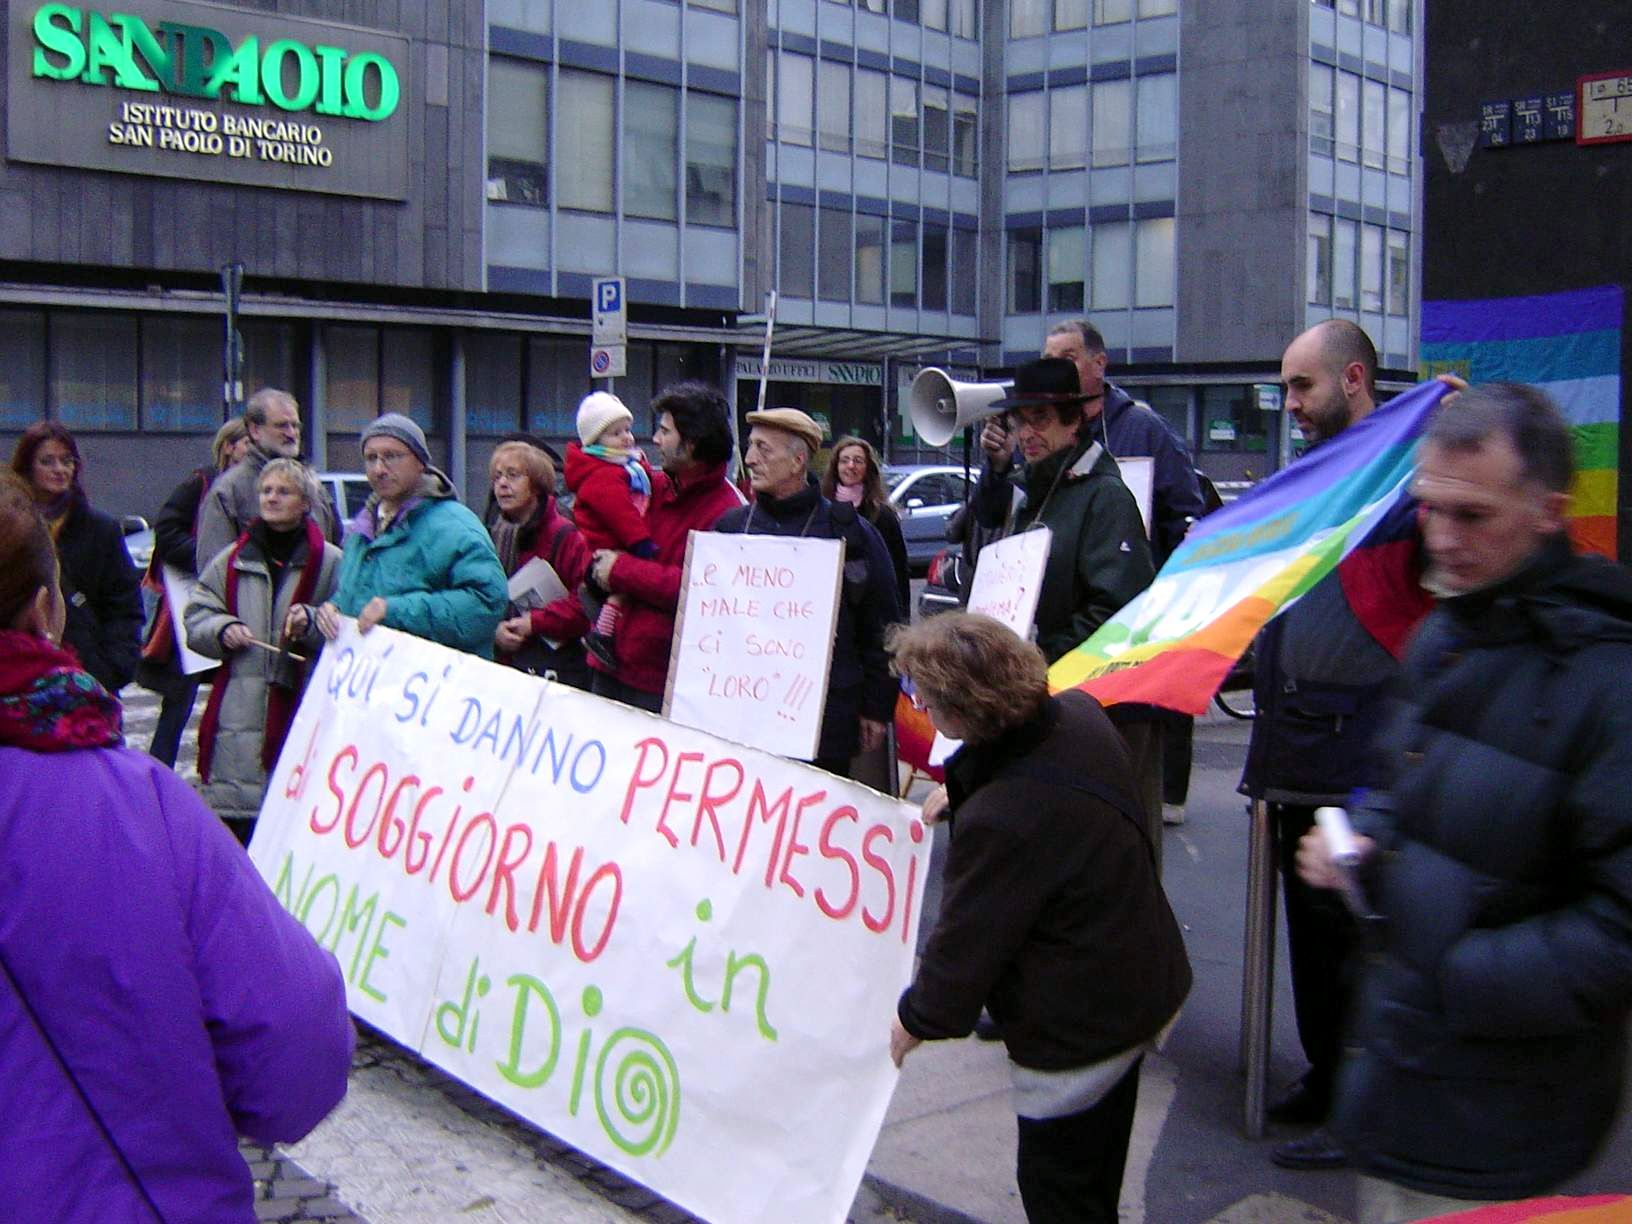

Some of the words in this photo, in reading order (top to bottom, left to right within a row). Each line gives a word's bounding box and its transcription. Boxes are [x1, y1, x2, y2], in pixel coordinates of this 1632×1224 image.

[109, 124, 153, 147] SAN
[159, 131, 223, 155] PAOLO
[228, 138, 251, 159] DI
[257, 141, 334, 168] TORINO
[122, 102, 218, 132] ISTITUTO
[223, 115, 322, 146] BANCARIO
[731, 565, 796, 588] MENO
[700, 597, 760, 618] MALE
[772, 601, 815, 620] CHE
[745, 633, 806, 660] SONO
[450, 697, 606, 794] DANNO
[275, 849, 407, 1003] NOME
[435, 955, 491, 1054] di
[666, 898, 778, 1042] in
